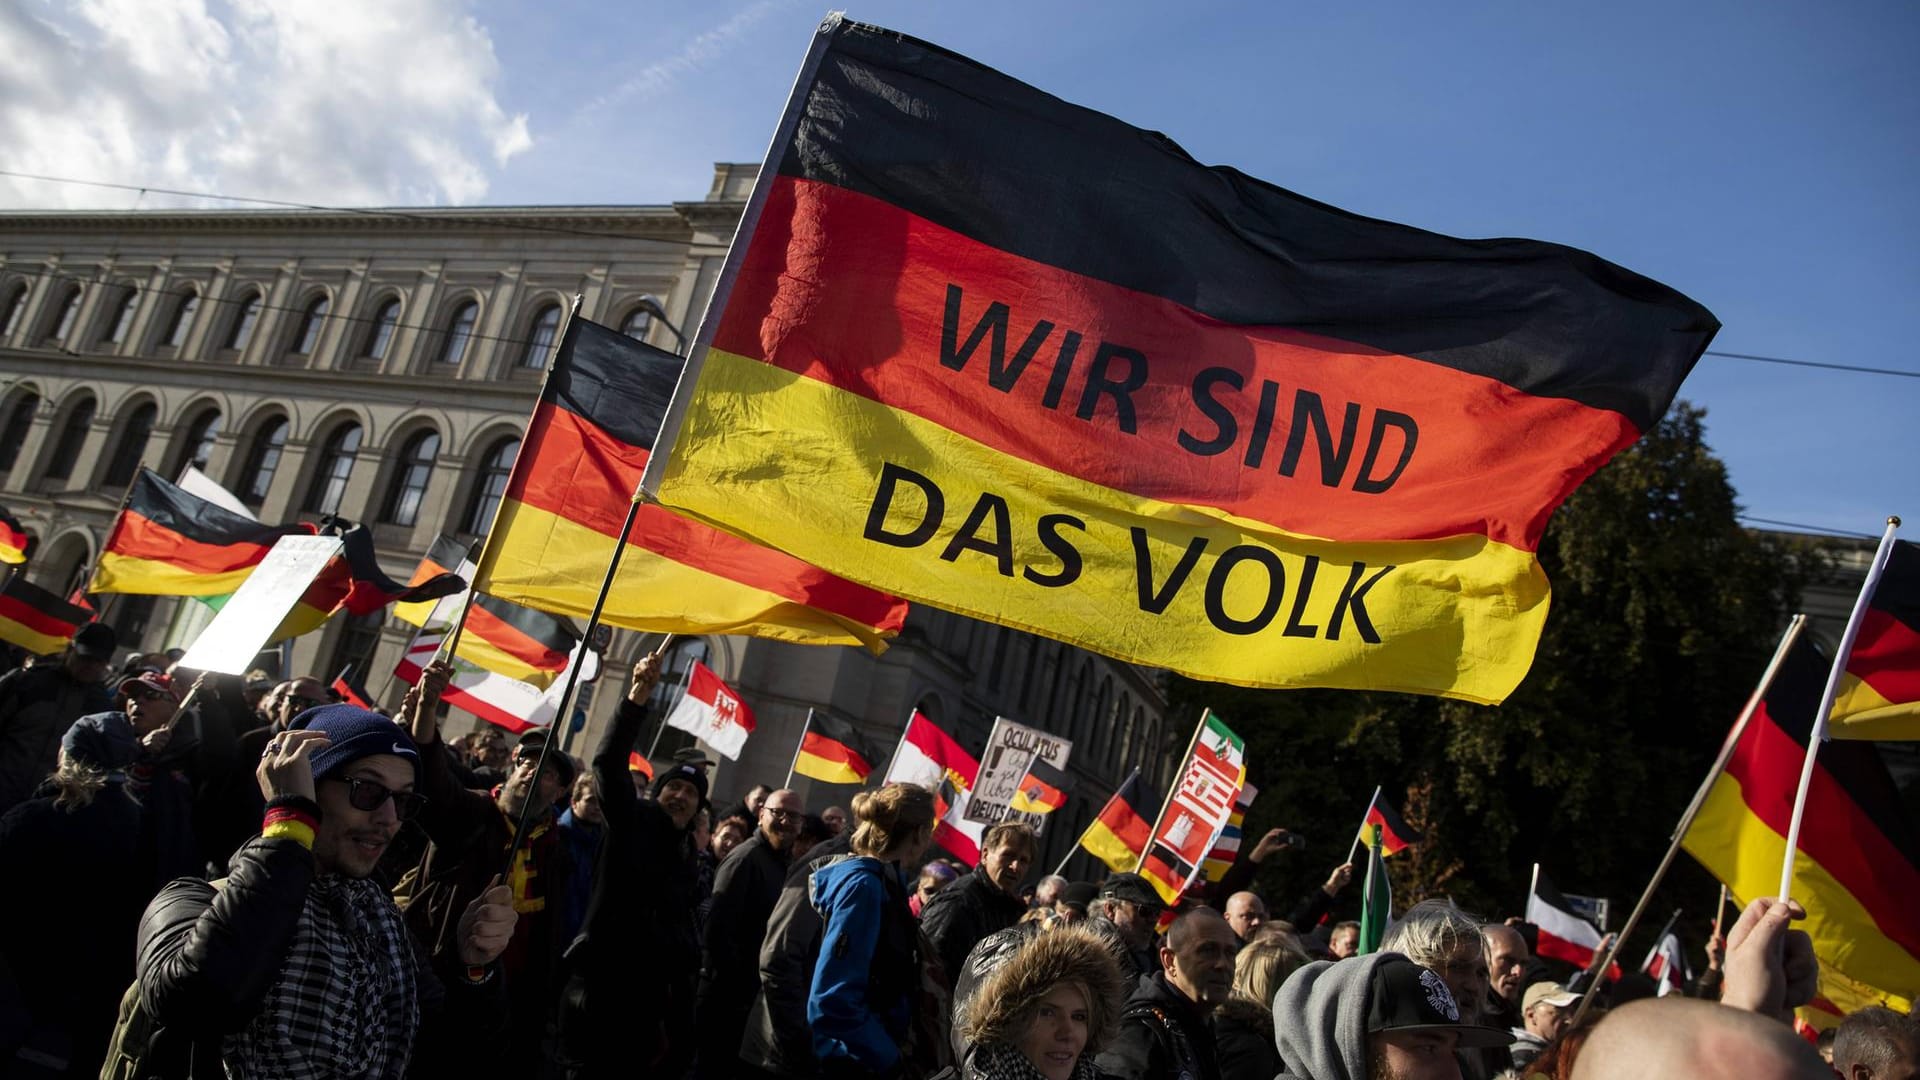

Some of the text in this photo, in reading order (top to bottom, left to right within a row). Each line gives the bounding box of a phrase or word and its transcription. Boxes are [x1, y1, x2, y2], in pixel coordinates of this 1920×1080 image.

[939, 283, 1419, 494] WIR SIND
[863, 461, 1396, 644] DAS VOLK
